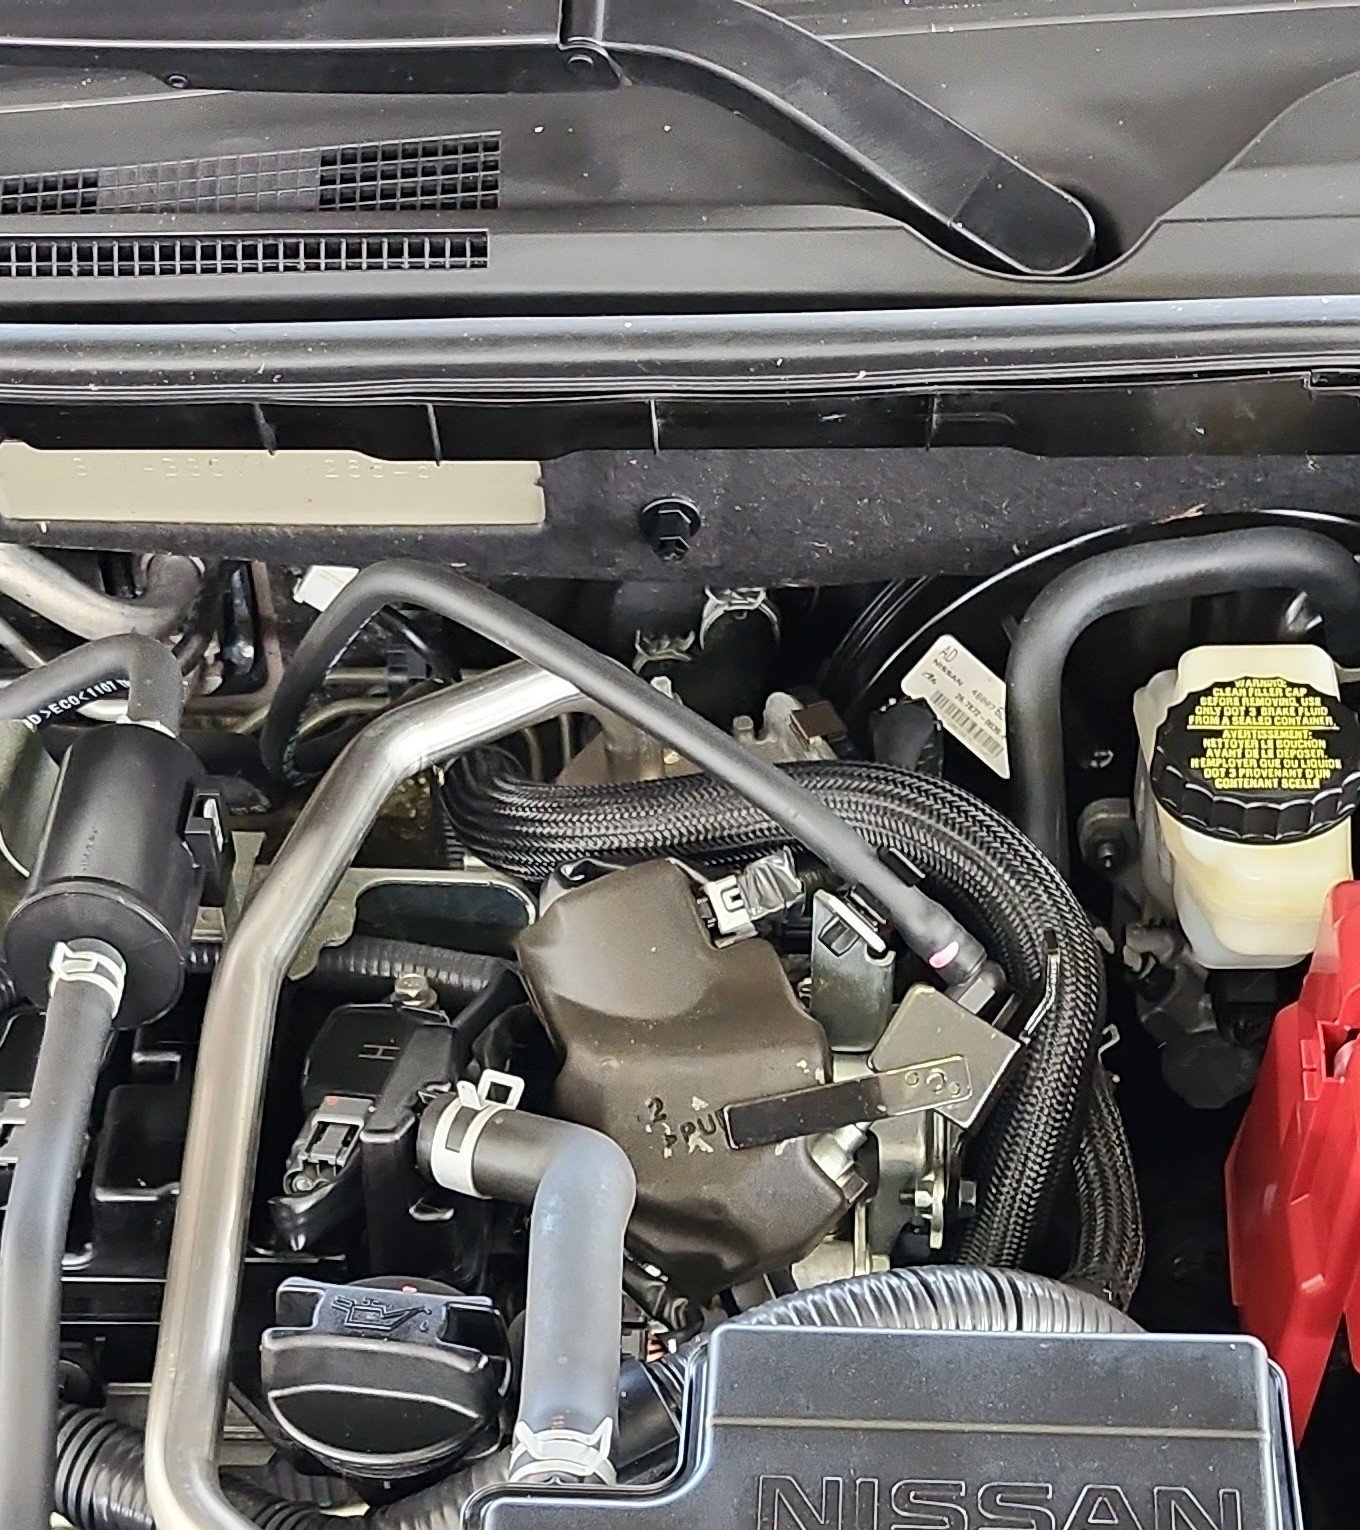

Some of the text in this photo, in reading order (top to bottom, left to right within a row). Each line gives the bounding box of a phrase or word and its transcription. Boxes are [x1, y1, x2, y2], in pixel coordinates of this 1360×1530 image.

[933, 658, 964, 687] NISSAN
[1212, 688, 1307, 697] CLEAN FILLER CAP
[1200, 697, 1321, 706] BEFORE USE
[1195, 706, 1329, 716] ONLY DOT 3 BRAKE FLUID
[1189, 716, 1220, 726] FROM
[1221, 716, 1230, 726] A
[1231, 716, 1273, 726] SEALED
[1203, 739, 1326, 748] NETTOYER LE BOUCHON
[1206, 749, 1243, 758] AVANT
[1244, 749, 1259, 758] DE
[1260, 749, 1274, 758] LE
[1260, 758, 1342, 768] QUE DU LIQUIDE
[1204, 768, 1304, 778] DOT 3 PROVENANT
[1214, 778, 1279, 789] CONTENANT
